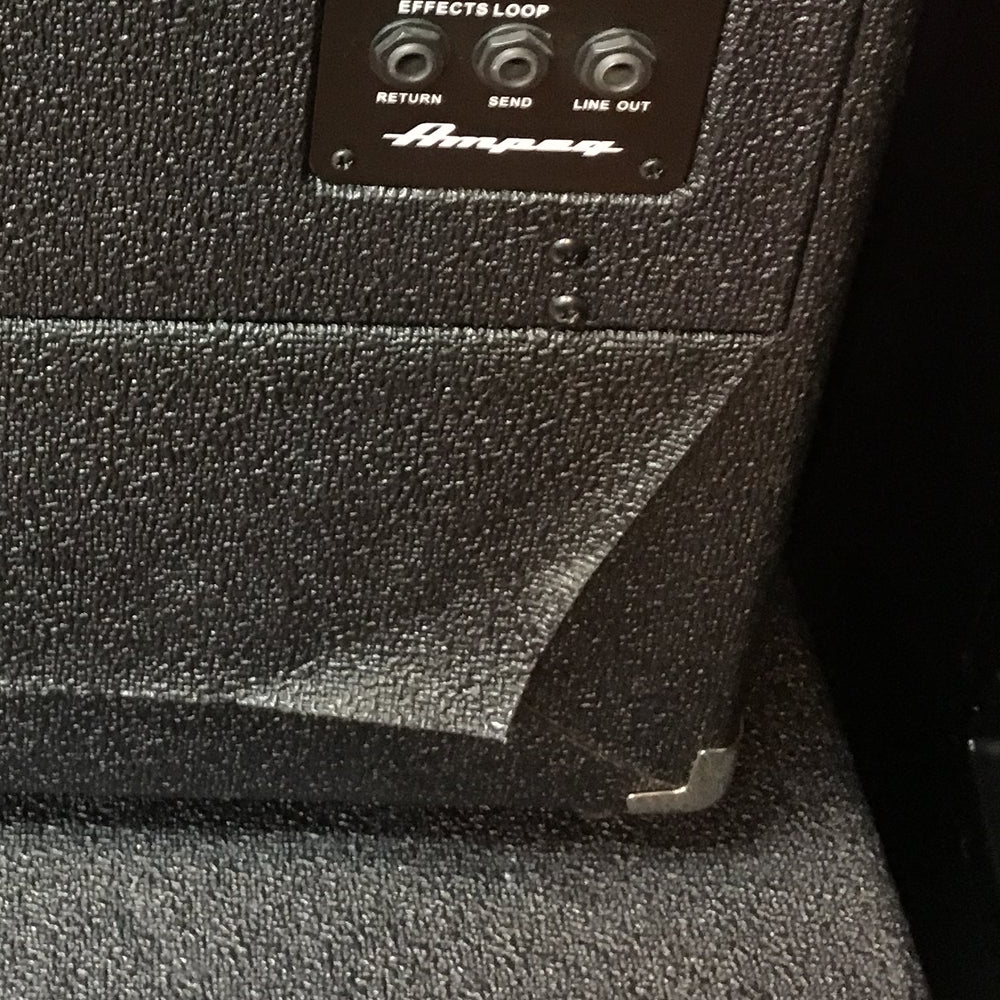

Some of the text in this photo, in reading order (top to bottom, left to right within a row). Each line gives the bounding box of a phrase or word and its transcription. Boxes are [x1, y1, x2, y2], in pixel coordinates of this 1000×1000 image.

[398, 0, 550, 18] EFFECTS LOOP
[375, 92, 442, 106] RETURN
[488, 95, 533, 109] SEND
[572, 98, 651, 112] LINE OUT
[382, 122, 624, 157] Ampeg
